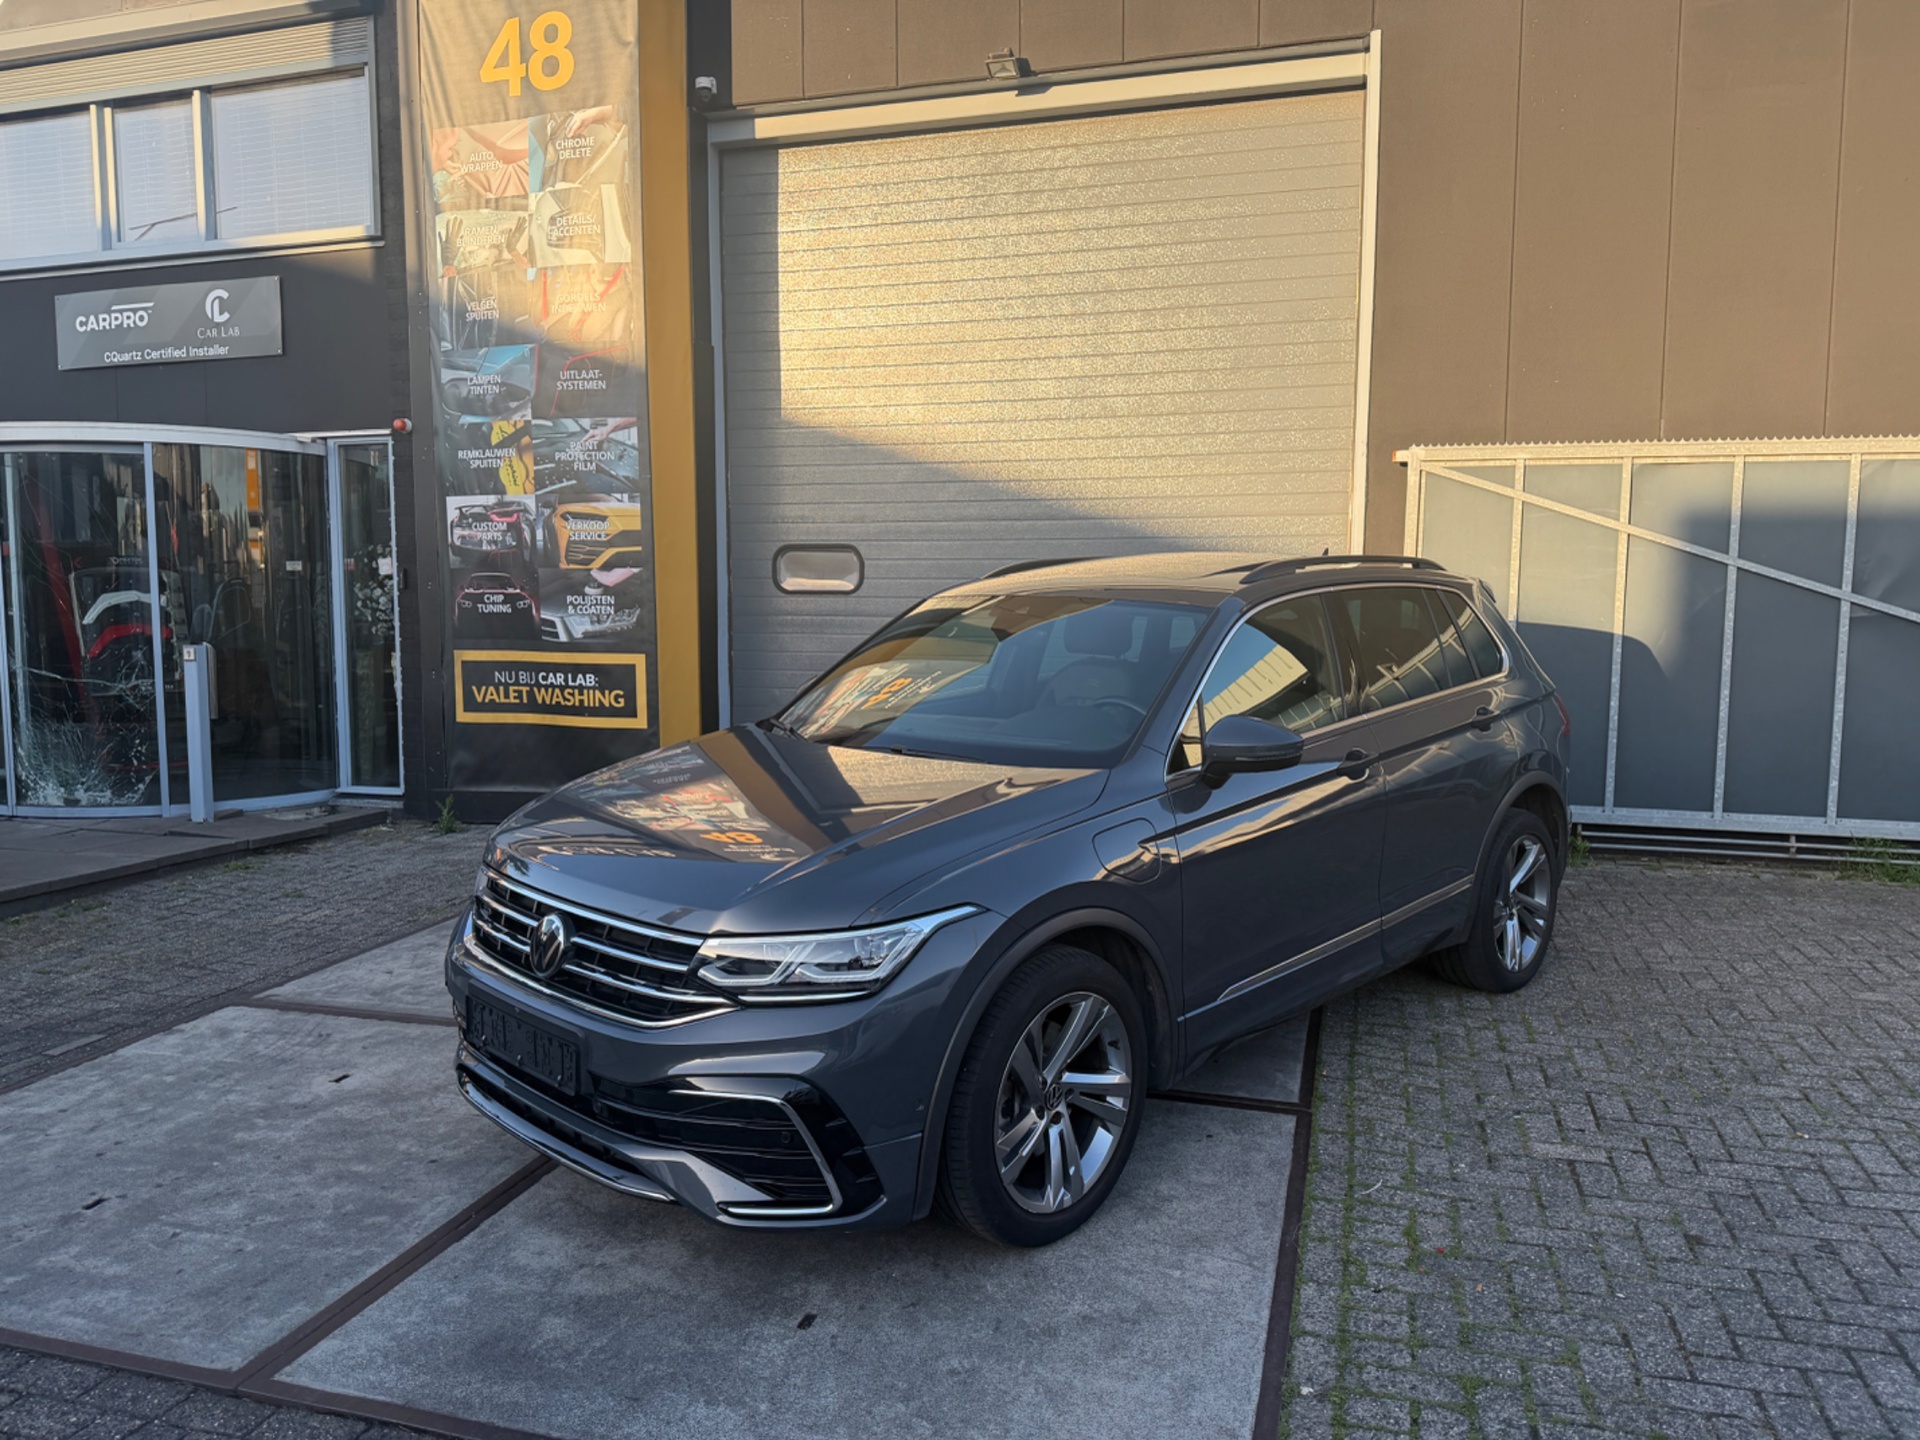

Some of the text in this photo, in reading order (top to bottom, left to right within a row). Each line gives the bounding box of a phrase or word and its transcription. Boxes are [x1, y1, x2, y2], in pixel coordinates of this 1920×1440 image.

[480, 10, 575, 96] 48
[556, 138, 595, 150] CHROME
[470, 151, 494, 162] AUTO
[559, 148, 592, 160] DELETE
[460, 160, 503, 173] WRAPPEN
[553, 224, 600, 237] ACCENTEN
[466, 299, 497, 312] VELGEN
[466, 310, 499, 322] SPUITEN
[104, 344, 230, 363] CQuartz Certified Installer
[467, 374, 500, 385] LAMPEN
[560, 370, 602, 380] UITLAAT-
[470, 384, 500, 394] TINTEN
[556, 380, 606, 390] SYSTEMEN
[570, 440, 598, 451] PAINT
[458, 448, 516, 460] REMKLAUWEN
[554, 450, 615, 462] PROTECTION
[470, 458, 504, 468] SPUITEN
[574, 461, 596, 471] FILM
[472, 522, 507, 532] CUSTOM
[566, 521, 610, 531] VERKOOP
[477, 532, 502, 542] PARTS
[569, 531, 607, 541] SERVICE
[484, 594, 504, 604] CHIP
[566, 595, 615, 606] POLIJSTEN
[477, 604, 512, 614] TUNING
[568, 605, 614, 615] & COATEN
[494, 671, 598, 687] NU BIJ CAR LAB:
[472, 685, 625, 708] VALET WASHING
